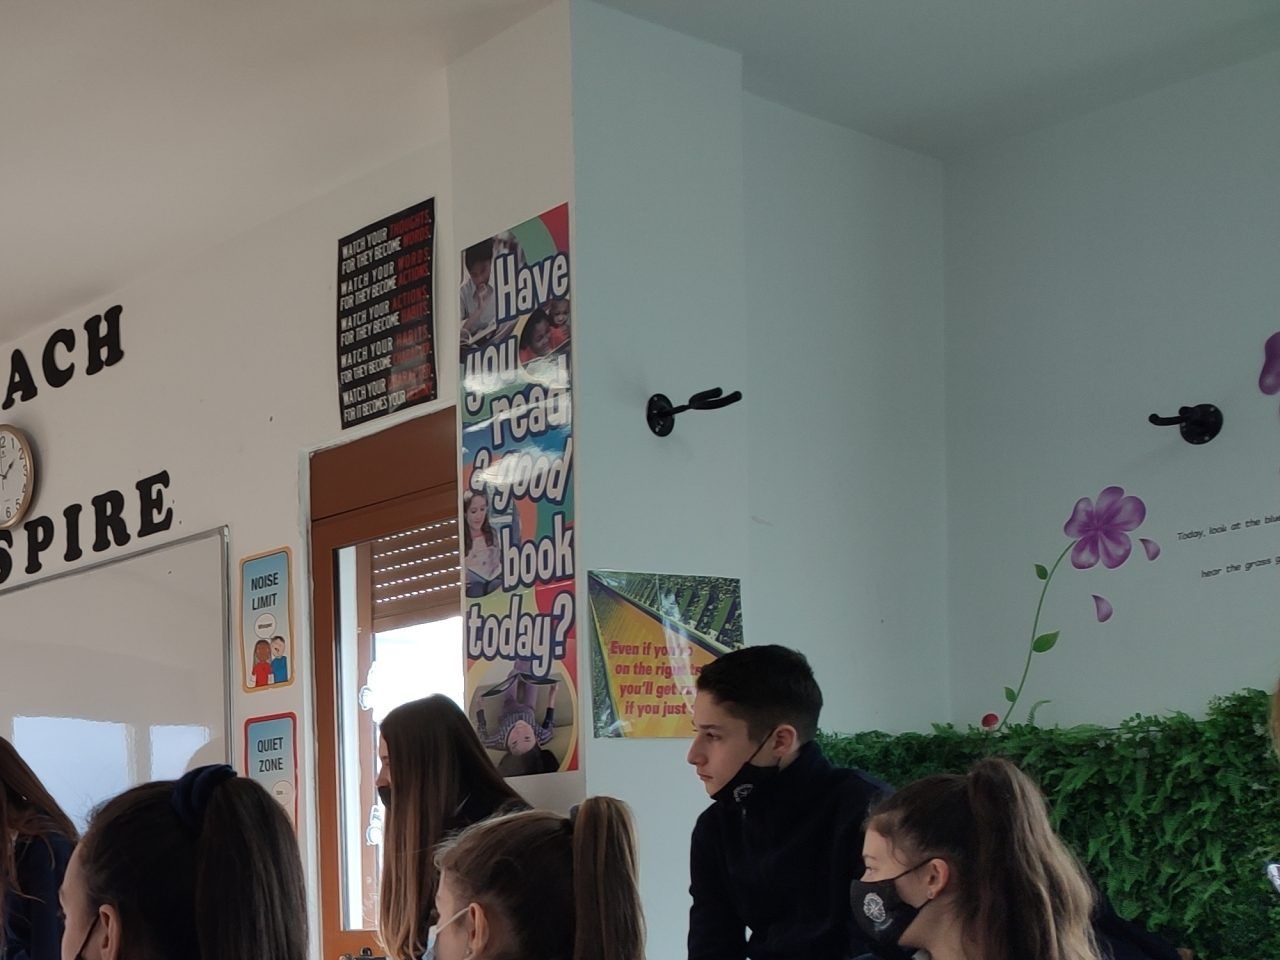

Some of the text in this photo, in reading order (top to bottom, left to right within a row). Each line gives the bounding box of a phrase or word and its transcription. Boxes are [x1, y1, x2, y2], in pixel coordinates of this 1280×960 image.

[342, 236, 366, 259] WATCH
[367, 227, 387, 247] YOUR
[342, 258, 356, 275] FOR
[356, 249, 374, 268] THEY
[374, 236, 402, 260] BECOME
[341, 272, 369, 295] WATCH
[372, 261, 394, 282] YOUR
[495, 254, 568, 320] Have
[340, 295, 354, 311] FOR
[355, 286, 371, 305] THEY
[371, 275, 397, 298] BECOME
[340, 309, 367, 331] WATCH
[369, 301, 389, 320] YOUR
[340, 330, 355, 347] FOR
[355, 322, 372, 341] THEY
[372, 311, 400, 334] BECOME
[340, 346, 368, 368] WATCH
[370, 337, 393, 357] YOUR
[340, 370, 353, 384] FOR
[353, 364, 368, 379] THEY
[368, 355, 392, 374] BECOME
[465, 339, 516, 411] you
[342, 385, 366, 406] WATCH
[367, 378, 386, 397] YOUR
[344, 407, 356, 422] FOR
[362, 396, 388, 416] BECOMES
[388, 390, 406, 408] YOUR
[491, 354, 570, 445] read
[10, 437, 15, 449] 1
[18, 447, 24, 460] 2
[471, 438, 572, 510] a good
[5, 506, 12, 519] 6
[1209, 524, 1227, 535] look
[1231, 522, 1241, 531] at
[1245, 519, 1261, 528] the
[502, 514, 573, 588] book
[251, 572, 279, 591] NOISE
[1201, 569, 1222, 578] hear
[1226, 564, 1241, 573] the
[1245, 559, 1271, 572] grass
[252, 593, 277, 610] LIMIT
[468, 593, 572, 677] today?
[610, 640, 639, 656] Even
[642, 642, 652, 656] if
[615, 664, 630, 675] on
[633, 661, 653, 676] the
[619, 681, 653, 698] you'll
[656, 682, 677, 699] get
[624, 701, 634, 715] if
[637, 704, 660, 718] you
[662, 701, 687, 718] just
[257, 737, 284, 753] QUIET
[259, 757, 284, 773] ZONE
